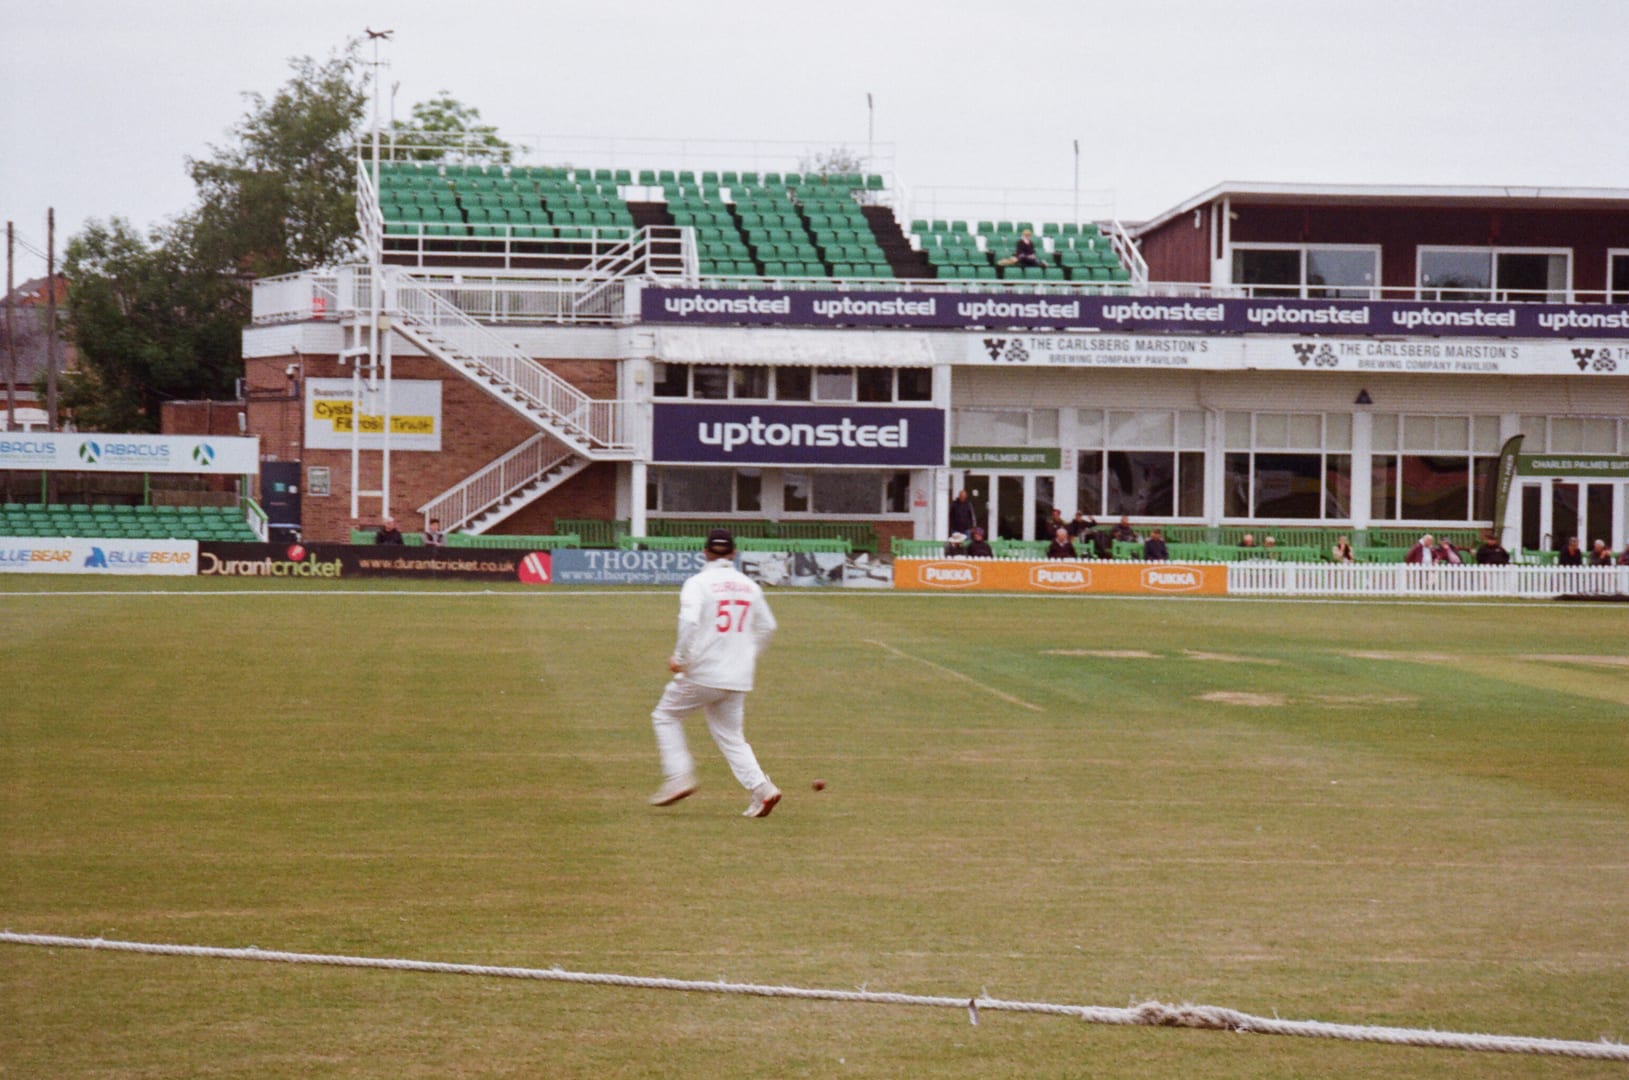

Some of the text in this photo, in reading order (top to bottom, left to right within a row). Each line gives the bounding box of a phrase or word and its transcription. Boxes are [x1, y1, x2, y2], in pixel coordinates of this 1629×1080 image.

[664, 294, 791, 317] uptonsteel
[812, 296, 937, 319] uptonsteel
[957, 298, 1081, 321] uptonsteel
[1102, 301, 1226, 324] uptonsteel
[1246, 304, 1370, 327] uptonsteel
[1392, 306, 1516, 329] uptonsteel
[1030, 338, 1208, 353] THE CARLSBERG MARSTON'S
[1339, 343, 1519, 359] THE CARLSBERG MARSTON'S
[1048, 353, 1188, 366] BREWING COMPANY PAVILION
[1357, 359, 1499, 372] BREWING COMPANY PAVILION
[698, 415, 909, 452] uptonsteel
[104, 443, 170, 456] ABACUS
[1531, 461, 1573, 469] CHARLES
[1574, 461, 1610, 470] PALMER
[109, 551, 191, 564] BLUEBEAR
[359, 558, 515, 572] www.durantcricket.co.uk
[584, 551, 707, 570] THORPES
[926, 568, 973, 582] PUKKA
[1037, 570, 1084, 584] PUKKA
[1149, 572, 1196, 586] PUKKA
[715, 599, 752, 633] 57
